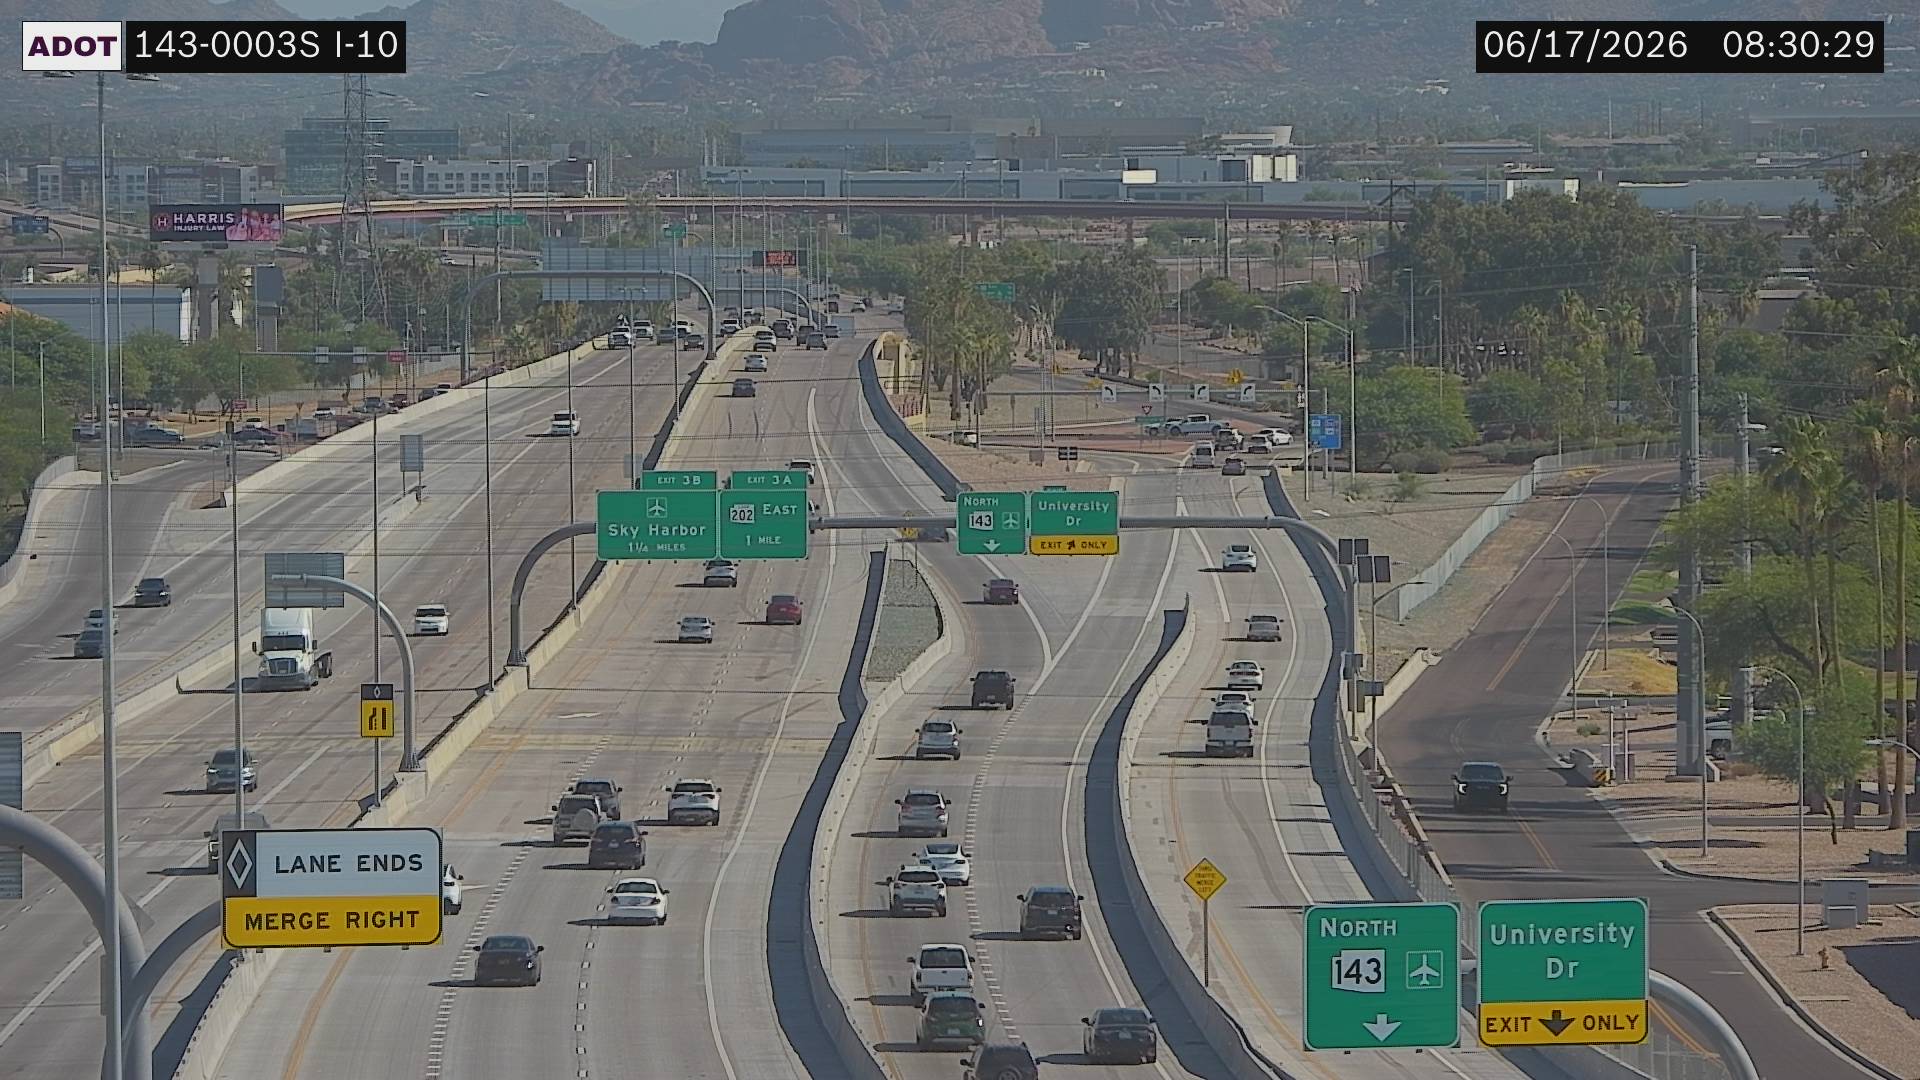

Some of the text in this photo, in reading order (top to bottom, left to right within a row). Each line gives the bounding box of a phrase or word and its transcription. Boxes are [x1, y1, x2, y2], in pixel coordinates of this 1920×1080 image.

[173, 213, 235, 224] HARRIS
[657, 475, 701, 485] EXIT 3B
[747, 476, 765, 485] EXIT
[963, 497, 999, 507] NORTH
[1038, 501, 1110, 514] University
[731, 509, 754, 522] 202
[762, 503, 798, 515] EAST
[970, 514, 993, 528] 143
[1066, 516, 1081, 527] Dr
[608, 523, 707, 539] Sky Harbor
[746, 535, 781, 546] 1 MILE
[1040, 541, 1108, 550] EXIT ONLY
[656, 543, 686, 552] MILES
[275, 853, 424, 874] LANE ENDS
[244, 910, 420, 931] MERGE RIGHT
[1320, 917, 1397, 938] NORTH
[1490, 921, 1636, 949] University
[1335, 957, 1382, 985] 143
[1546, 957, 1580, 979] Dr
[1486, 1014, 1639, 1033] EXIT ONLY
